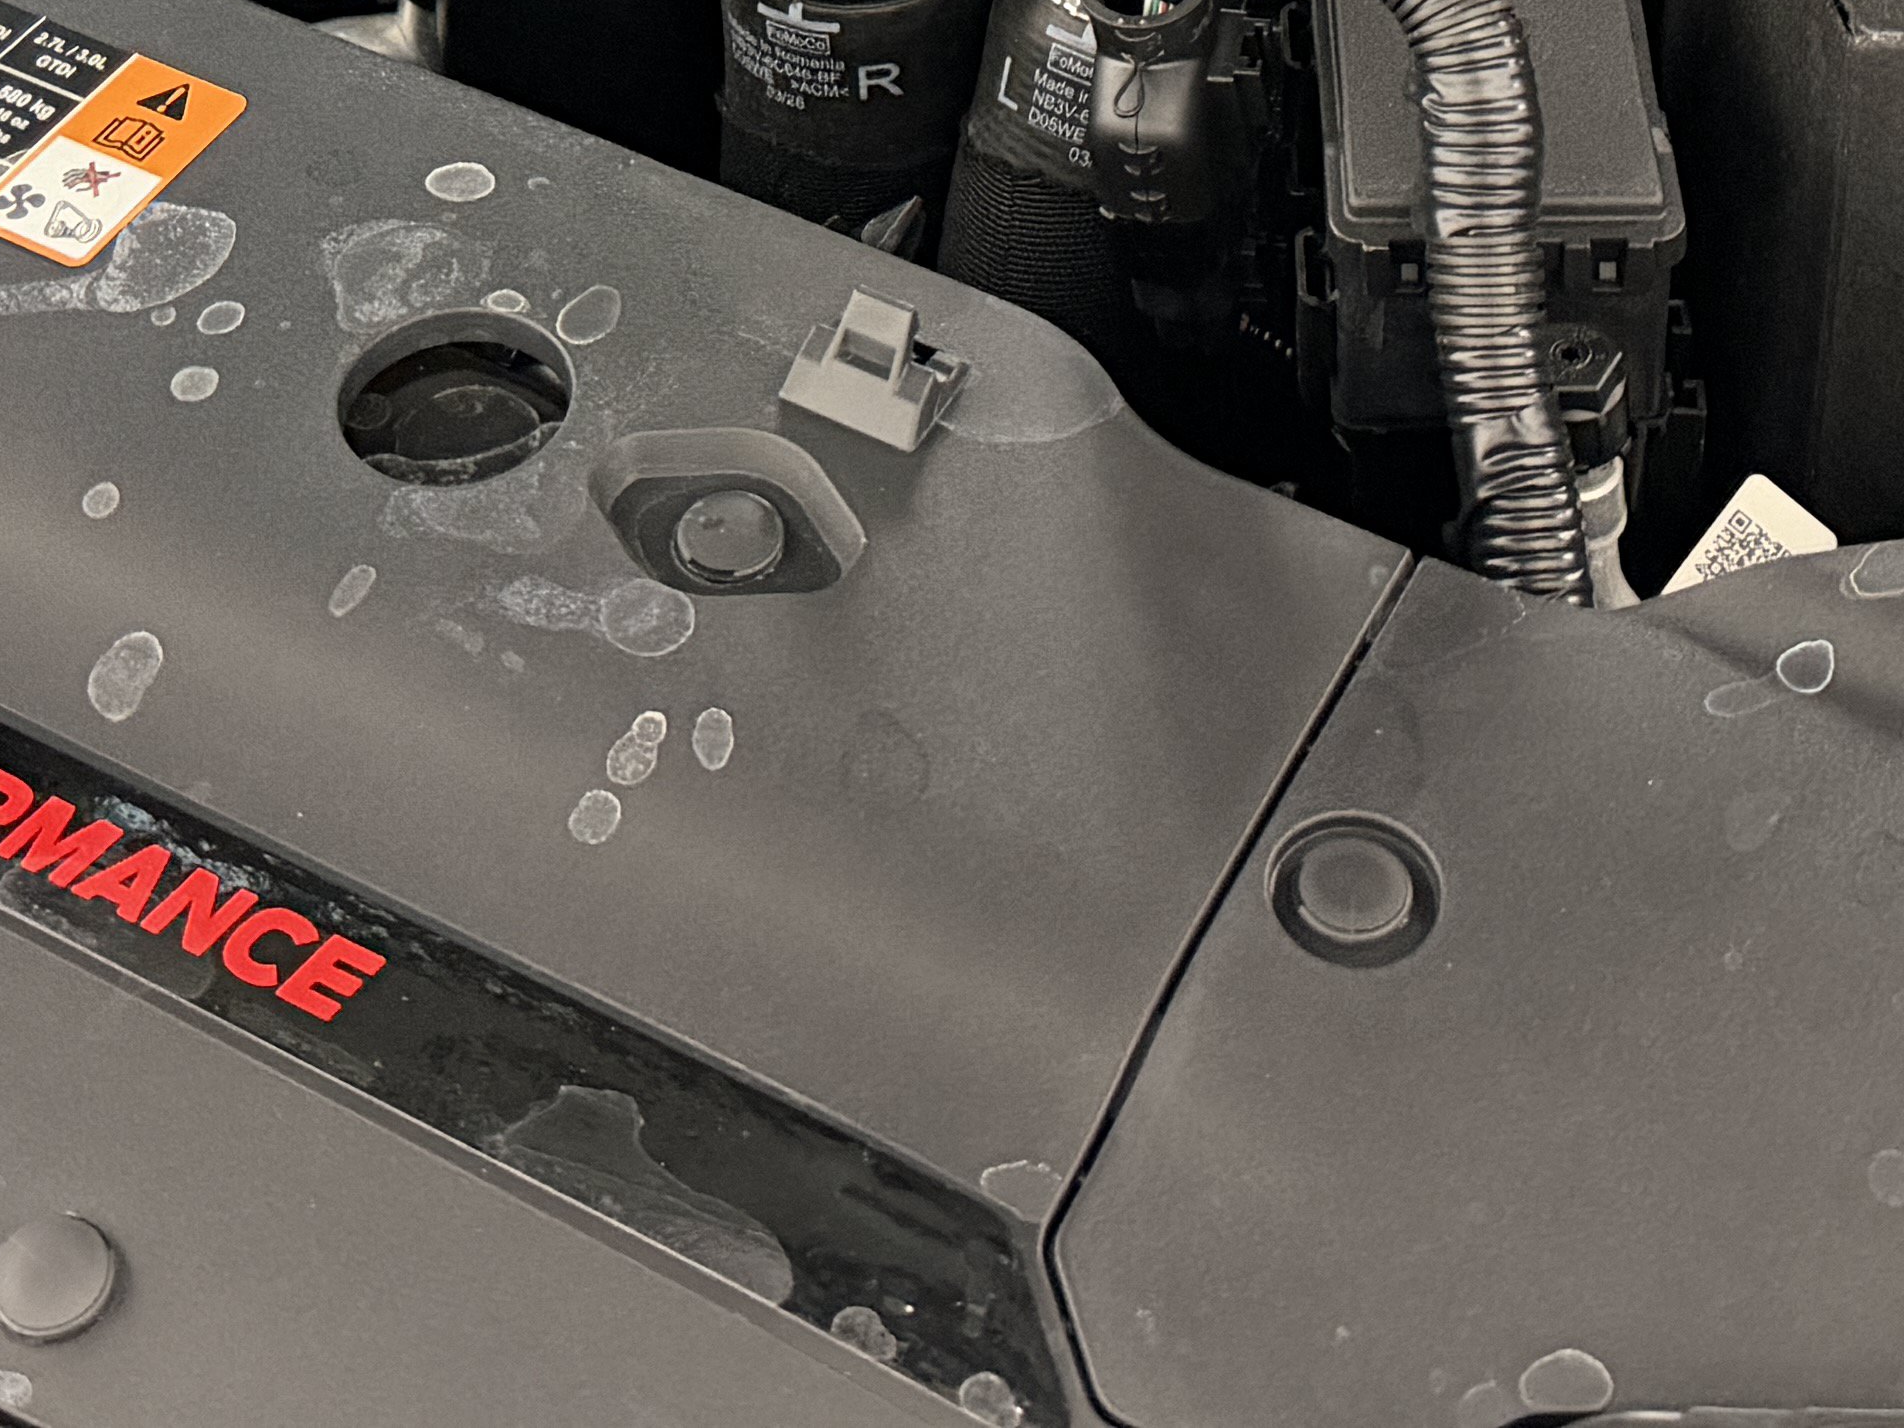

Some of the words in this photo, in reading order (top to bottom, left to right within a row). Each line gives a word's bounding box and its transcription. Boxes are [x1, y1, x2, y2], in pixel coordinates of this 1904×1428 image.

[32, 31, 64, 54] 2.7L
[74, 49, 108, 72] 3.0L
[35, 55, 76, 80] GTDI
[857, 62, 905, 102] R
[997, 55, 1019, 112] L
[1033, 67, 1075, 99] Made
[9, 114, 31, 132] oz
[30, 97, 57, 121] kg
